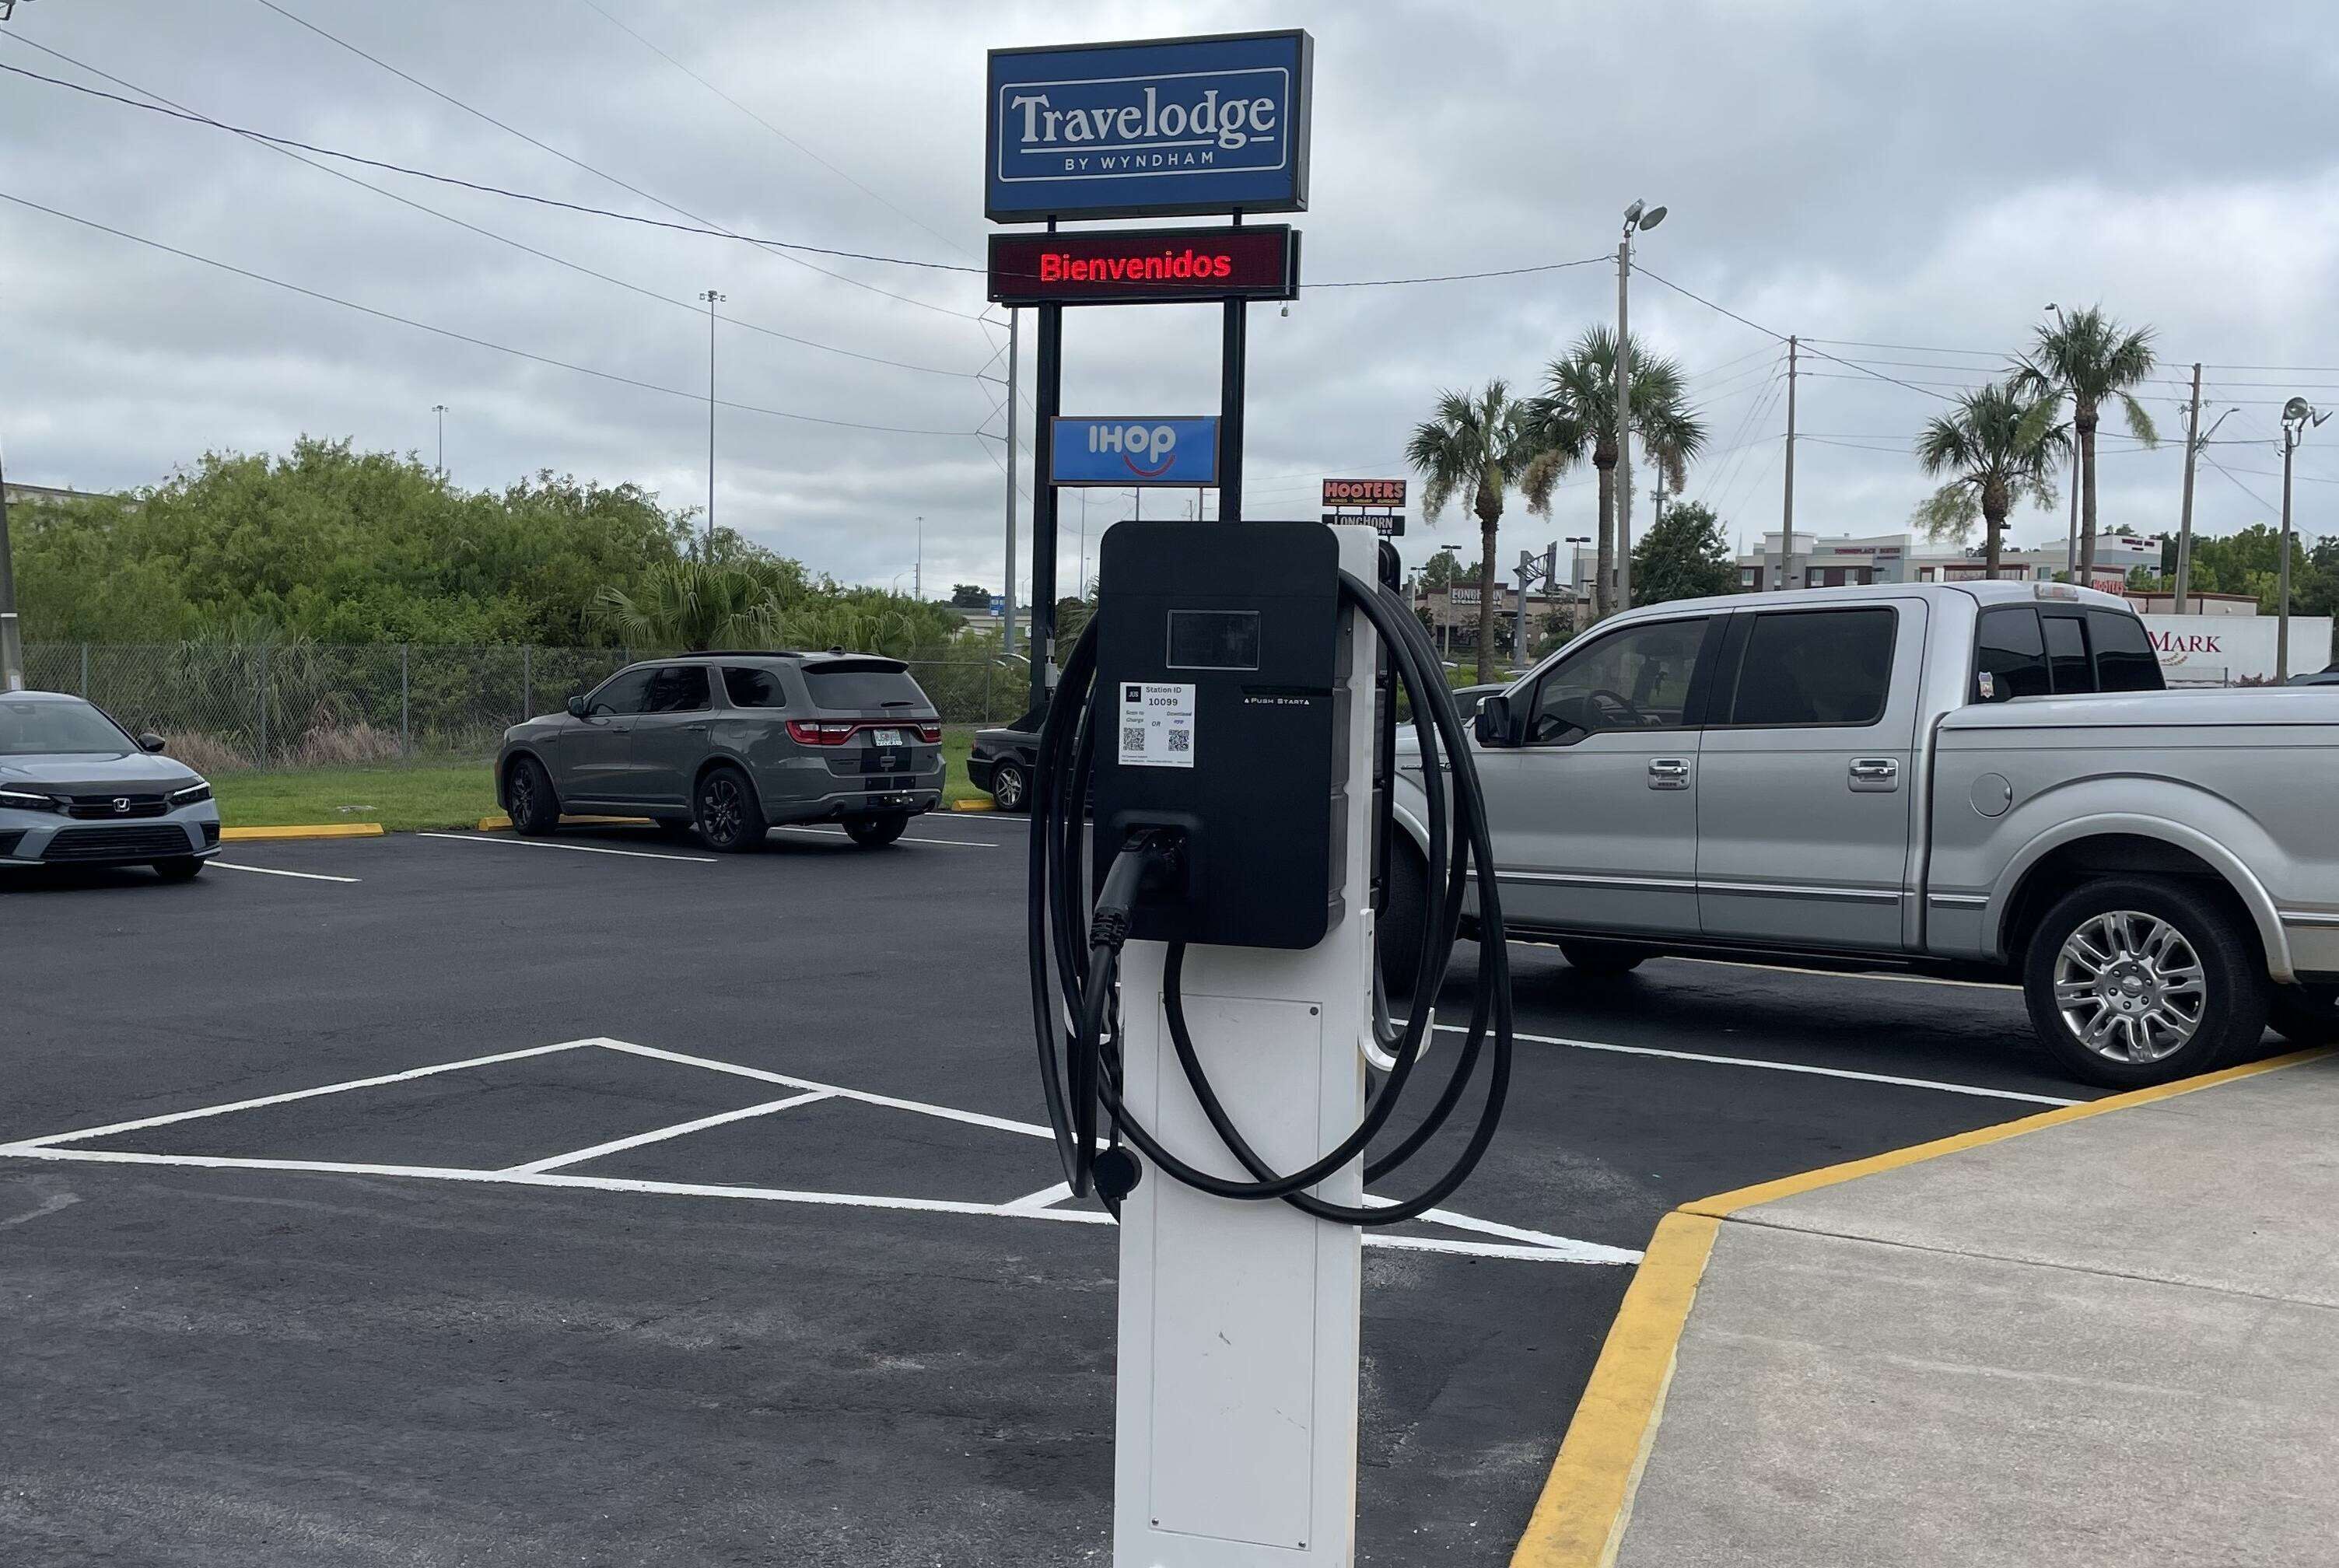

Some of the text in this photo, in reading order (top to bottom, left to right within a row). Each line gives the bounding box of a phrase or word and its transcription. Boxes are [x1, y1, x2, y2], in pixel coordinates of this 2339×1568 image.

[1011, 86, 1276, 150] Travelodge
[1065, 151, 1214, 171] BY WYNDHAM
[1041, 250, 1231, 282] Bienvenidos
[1325, 482, 1404, 499] HOOTERS
